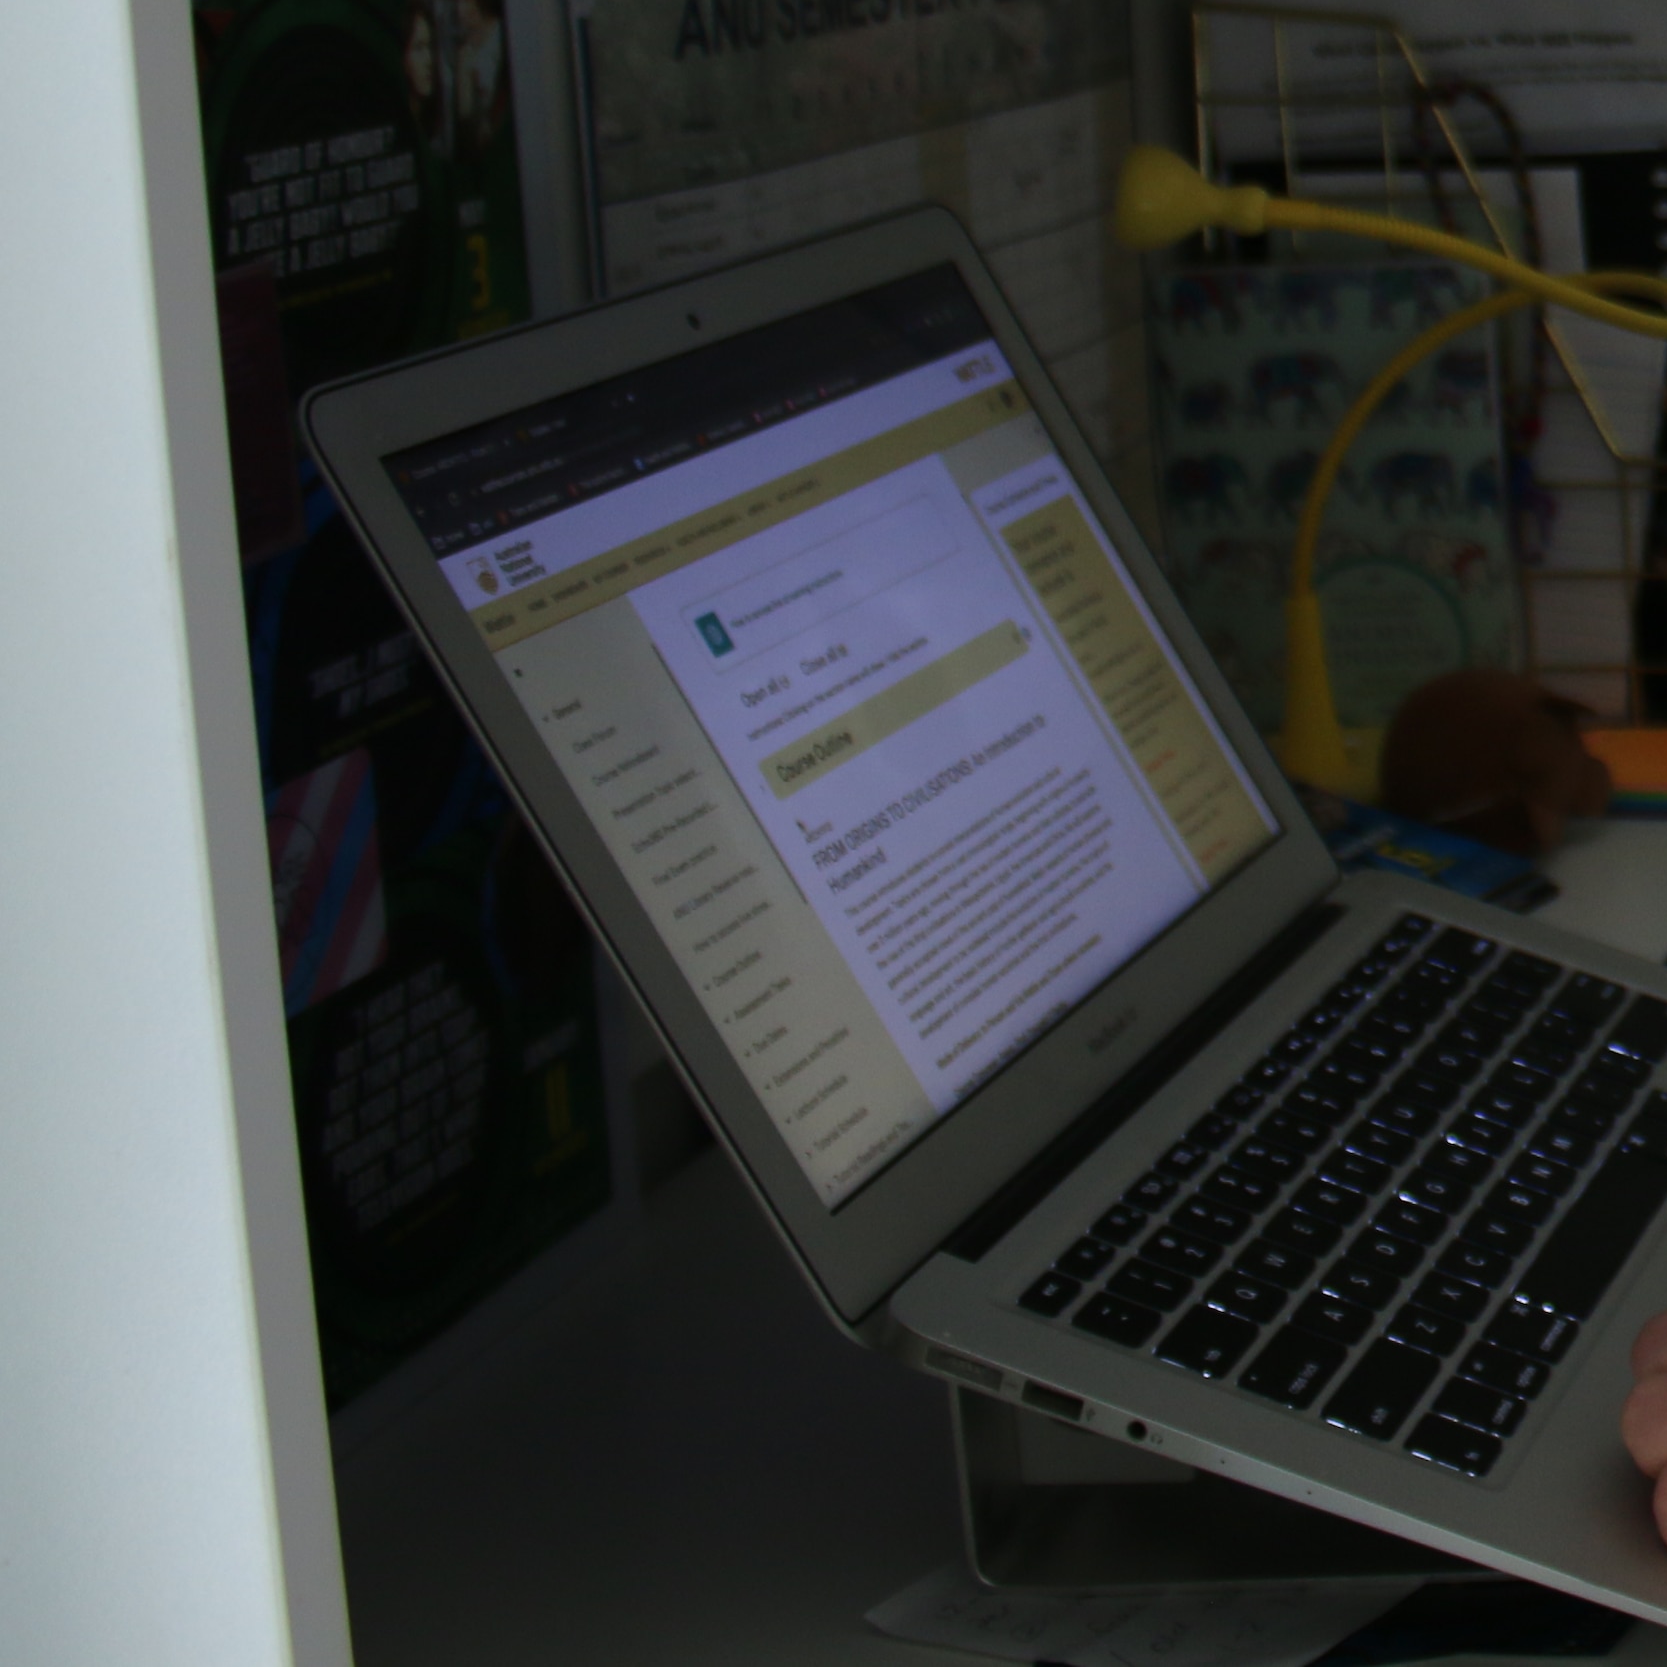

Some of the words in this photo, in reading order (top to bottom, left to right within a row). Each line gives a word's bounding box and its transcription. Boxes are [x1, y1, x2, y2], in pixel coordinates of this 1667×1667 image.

[774, 748, 818, 784] Course
[811, 725, 855, 763] Outline
[810, 837, 849, 872] FROM
[842, 810, 892, 852] ORIGINS
[885, 800, 907, 824] TO
[825, 845, 888, 896] Humankind
